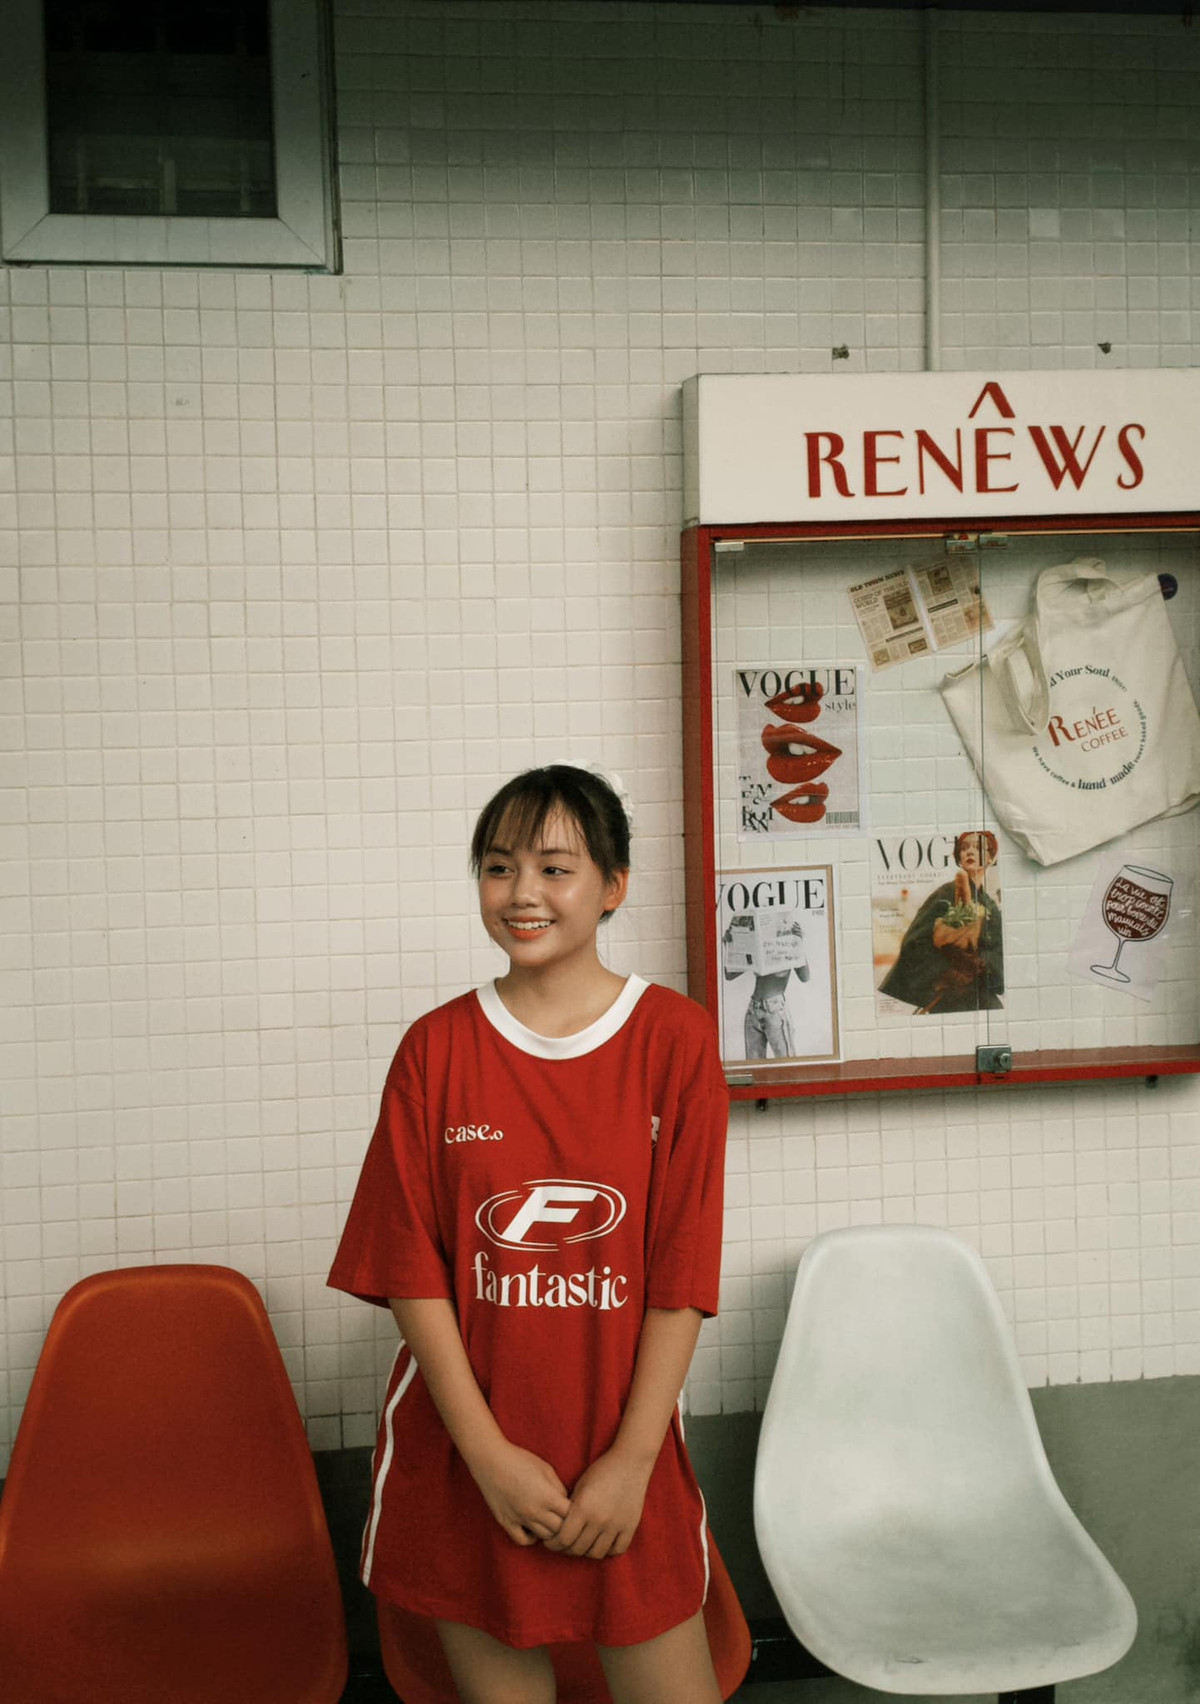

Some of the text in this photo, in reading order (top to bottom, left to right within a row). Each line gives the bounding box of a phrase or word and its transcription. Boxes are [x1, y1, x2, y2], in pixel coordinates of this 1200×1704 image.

[738, 668, 855, 698] VOGUE
[1055, 666, 1083, 681] Your
[1085, 664, 1110, 677] Soul
[825, 700, 856, 713] style
[1081, 727, 1129, 752] COFFEE
[1050, 771, 1069, 785] coffee
[1078, 779, 1107, 790] hand
[1109, 761, 1135, 784] made
[471, 1251, 629, 1310] fantastic
